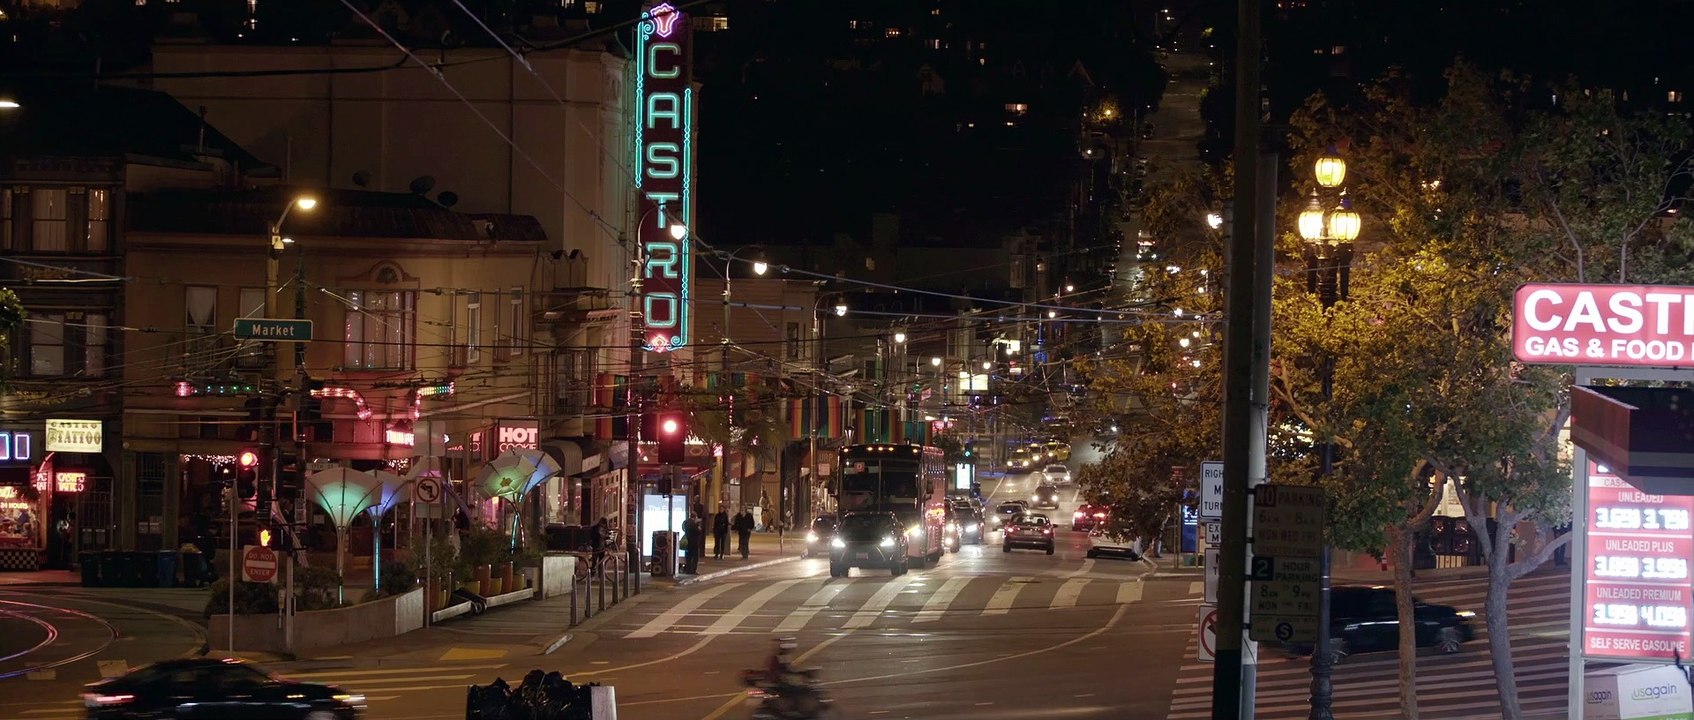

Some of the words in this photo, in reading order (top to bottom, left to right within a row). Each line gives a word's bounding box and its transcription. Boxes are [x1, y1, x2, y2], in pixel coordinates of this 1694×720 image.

[644, 42, 681, 329] CASTRO
[1524, 289, 1694, 336] CAST
[252, 323, 295, 336] Market
[1525, 336, 1580, 357] GAS
[1586, 338, 1605, 358] &
[1611, 339, 1684, 360] FOOD
[57, 430, 101, 445] TATTOO
[500, 427, 538, 443] HOT
[500, 442, 537, 452] COOKIE
[1204, 469, 1224, 479] RIGH
[1256, 487, 1275, 505] NO
[1618, 491, 1664, 503] UNLEADED
[1606, 539, 1650, 551] UNLEADED
[1652, 541, 1674, 552] PLUS
[249, 552, 258, 560] DO
[250, 568, 270, 576] ENTER
[1256, 559, 1268, 577] 2
[1282, 561, 1311, 572] HOUR
[1275, 572, 1318, 583] PARKING
[1596, 587, 1641, 599] UNLEADED
[1642, 589, 1682, 601] PREMIUM
[1258, 600, 1277, 610] MON
[1279, 624, 1290, 639] S
[1591, 637, 1612, 649] SELF
[1613, 639, 1641, 651] SERVE
[1642, 640, 1685, 652] GASOLINE
[1586, 688, 1613, 703] usagain
[1633, 682, 1678, 699] usagain
